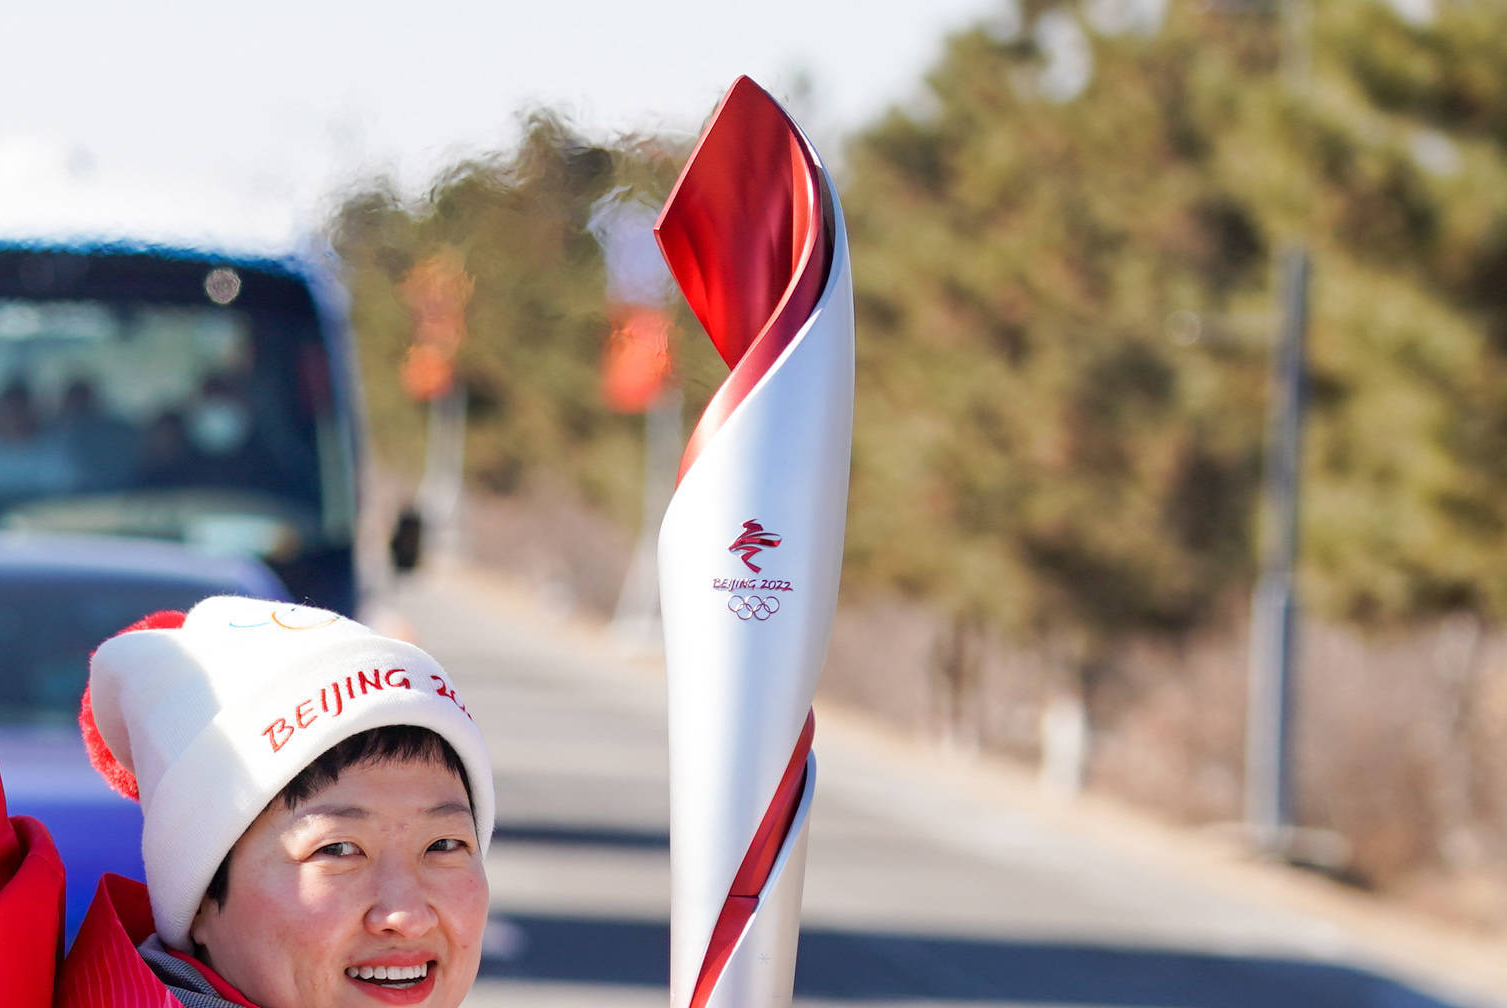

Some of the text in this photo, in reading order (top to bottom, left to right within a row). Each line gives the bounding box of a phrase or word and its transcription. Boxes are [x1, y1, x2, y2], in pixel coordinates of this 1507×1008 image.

[712, 578, 794, 592] BEIJING 2022
[261, 667, 412, 754] BEIJING
